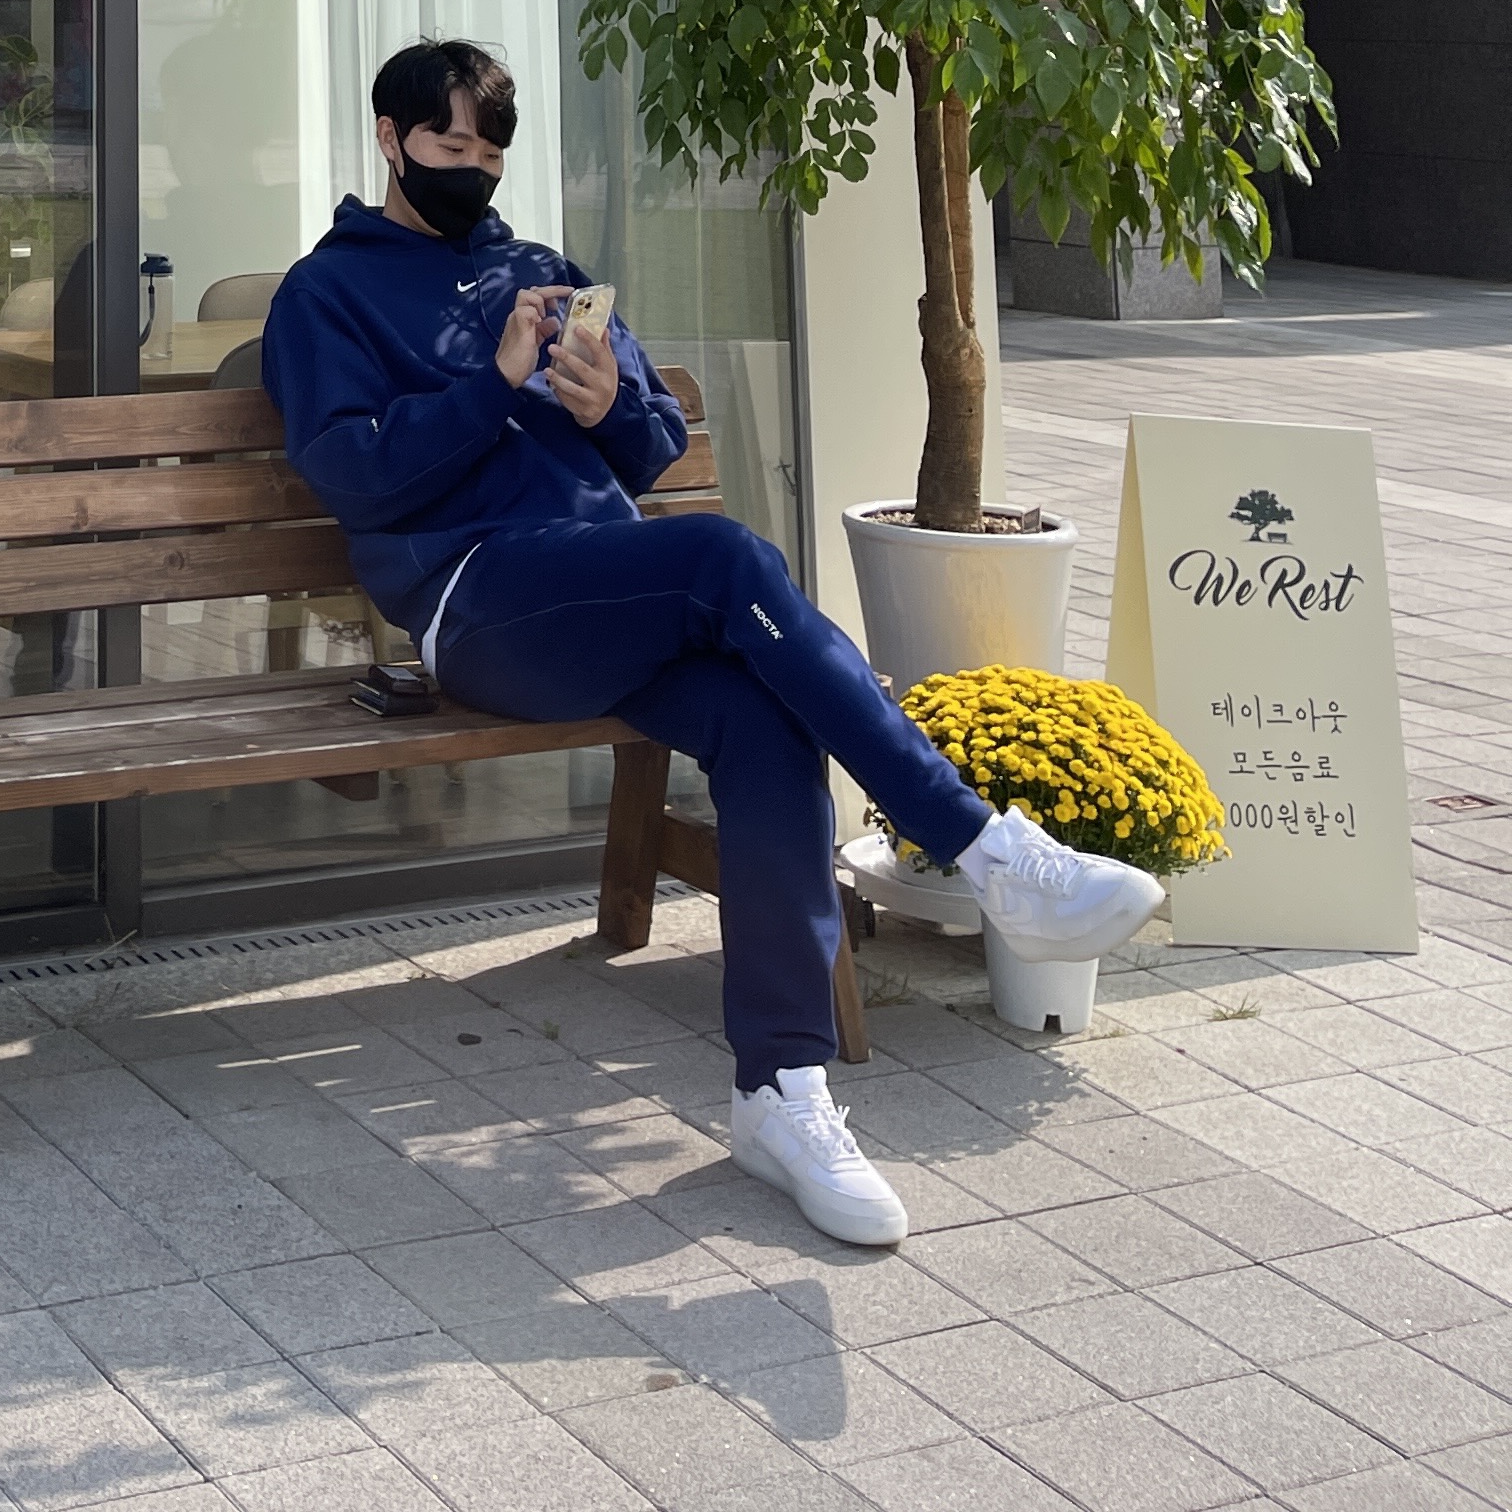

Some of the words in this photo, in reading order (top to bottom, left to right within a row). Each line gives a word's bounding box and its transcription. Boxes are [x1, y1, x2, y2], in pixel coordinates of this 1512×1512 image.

[750, 602, 783, 640] NOCTA
[1210, 692, 1348, 734] 테이크아웃
[1228, 750, 1340, 782] 모든음료
[1223, 800, 1356, 837] 000원할인
